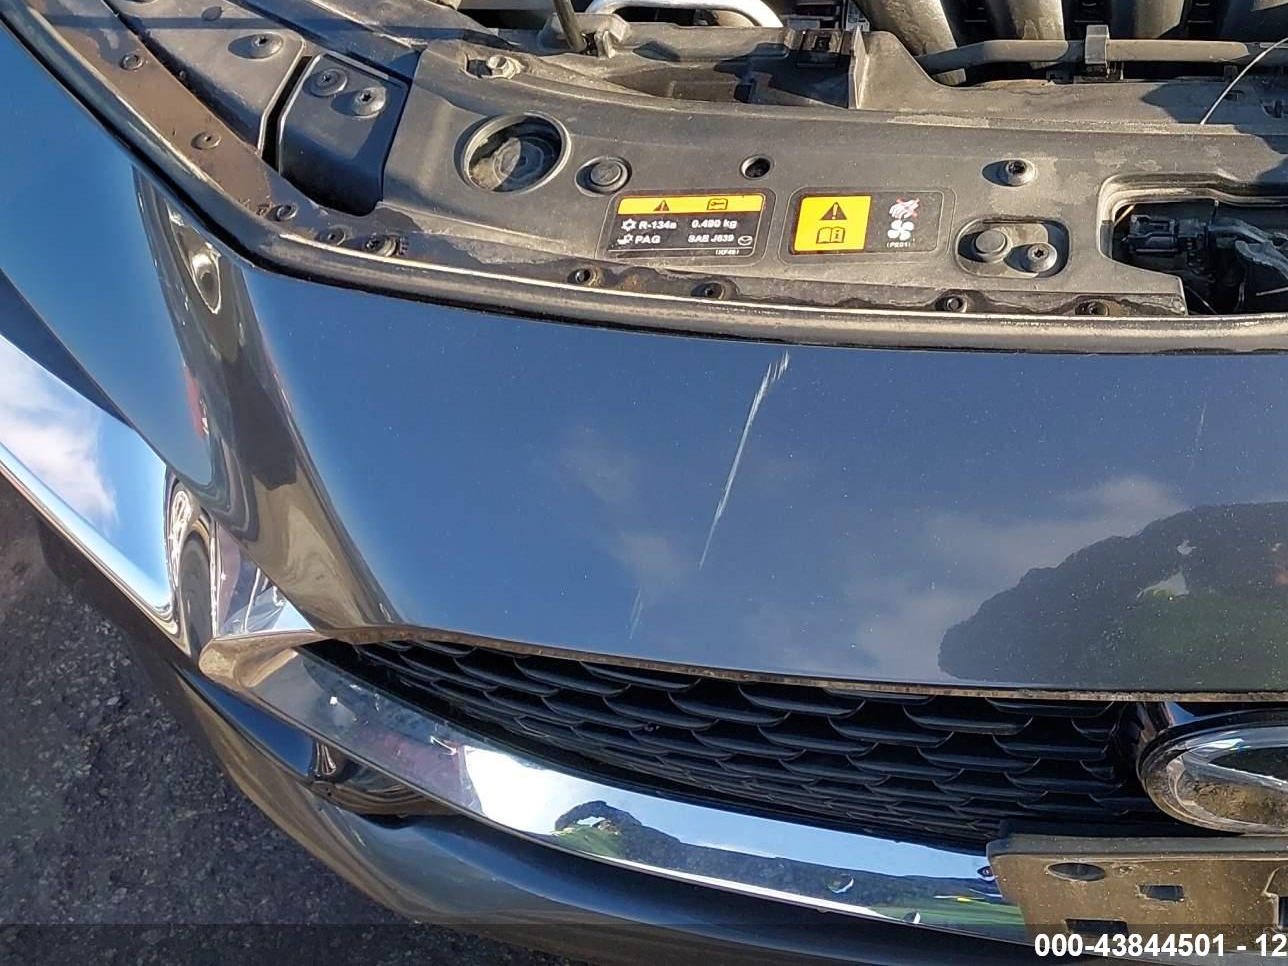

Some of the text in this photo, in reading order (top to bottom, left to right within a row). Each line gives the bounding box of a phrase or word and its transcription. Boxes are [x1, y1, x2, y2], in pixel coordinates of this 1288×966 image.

[638, 220, 678, 230] R-134a
[722, 218, 738, 230] kg
[634, 235, 661, 244] PAG
[687, 234, 710, 243] SAE
